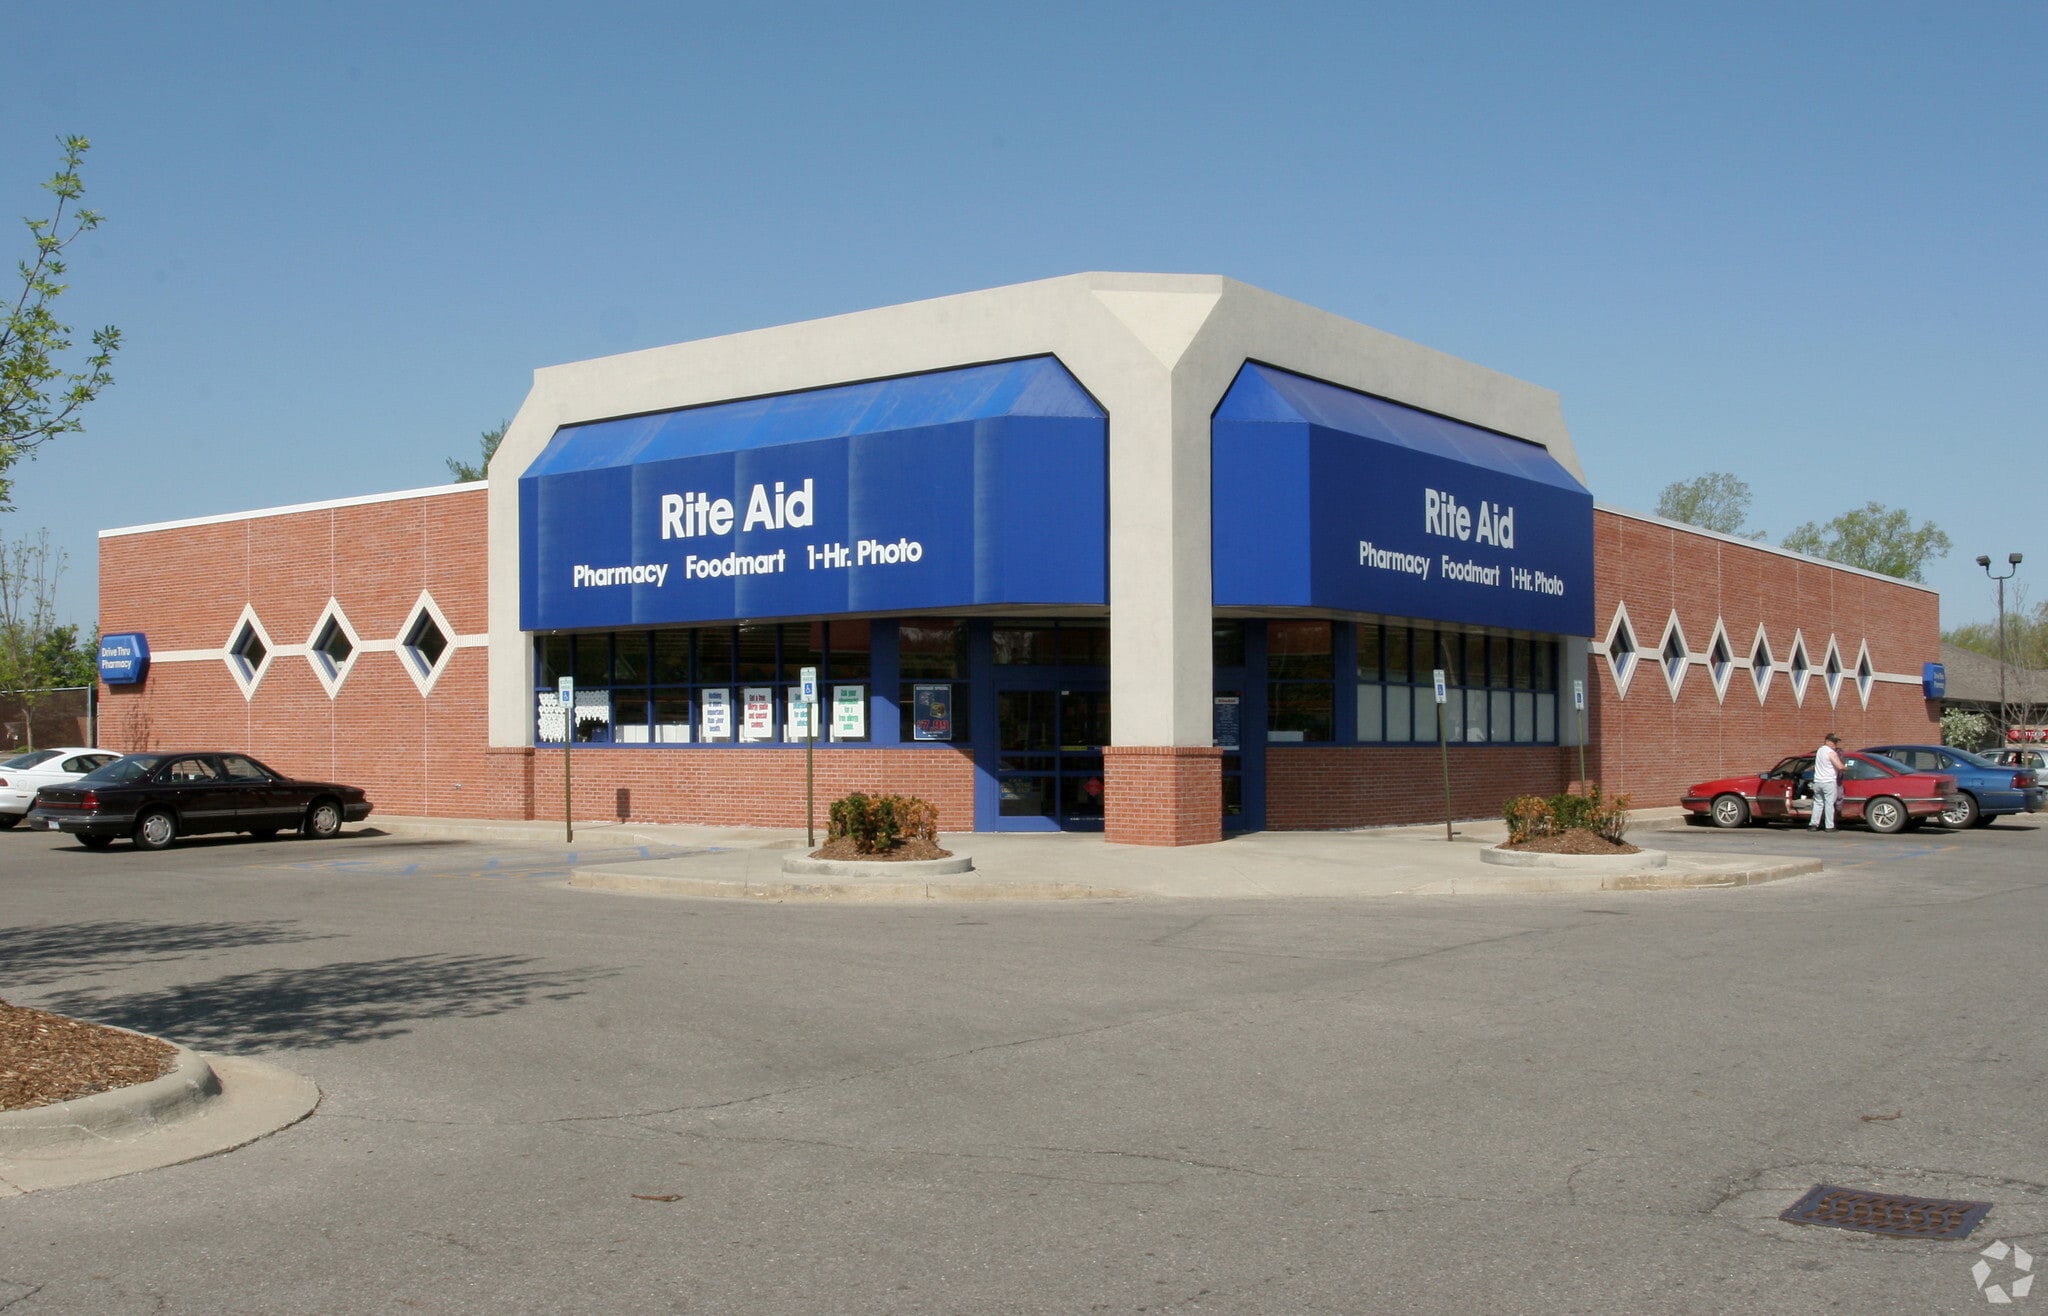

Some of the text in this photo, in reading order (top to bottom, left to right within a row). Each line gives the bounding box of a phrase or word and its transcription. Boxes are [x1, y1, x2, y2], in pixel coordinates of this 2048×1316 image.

[661, 477, 814, 540] Rite Aid
[1425, 487, 1514, 550] Rite Aid
[573, 537, 923, 588] Pharmacy Foodmart 1-Hr. Photo
[1359, 540, 1564, 597] Pharmacy Foodmart 1-Hr. Photo
[101, 646, 130, 657] Drive Thru
[101, 659, 132, 670] Pharmacy
